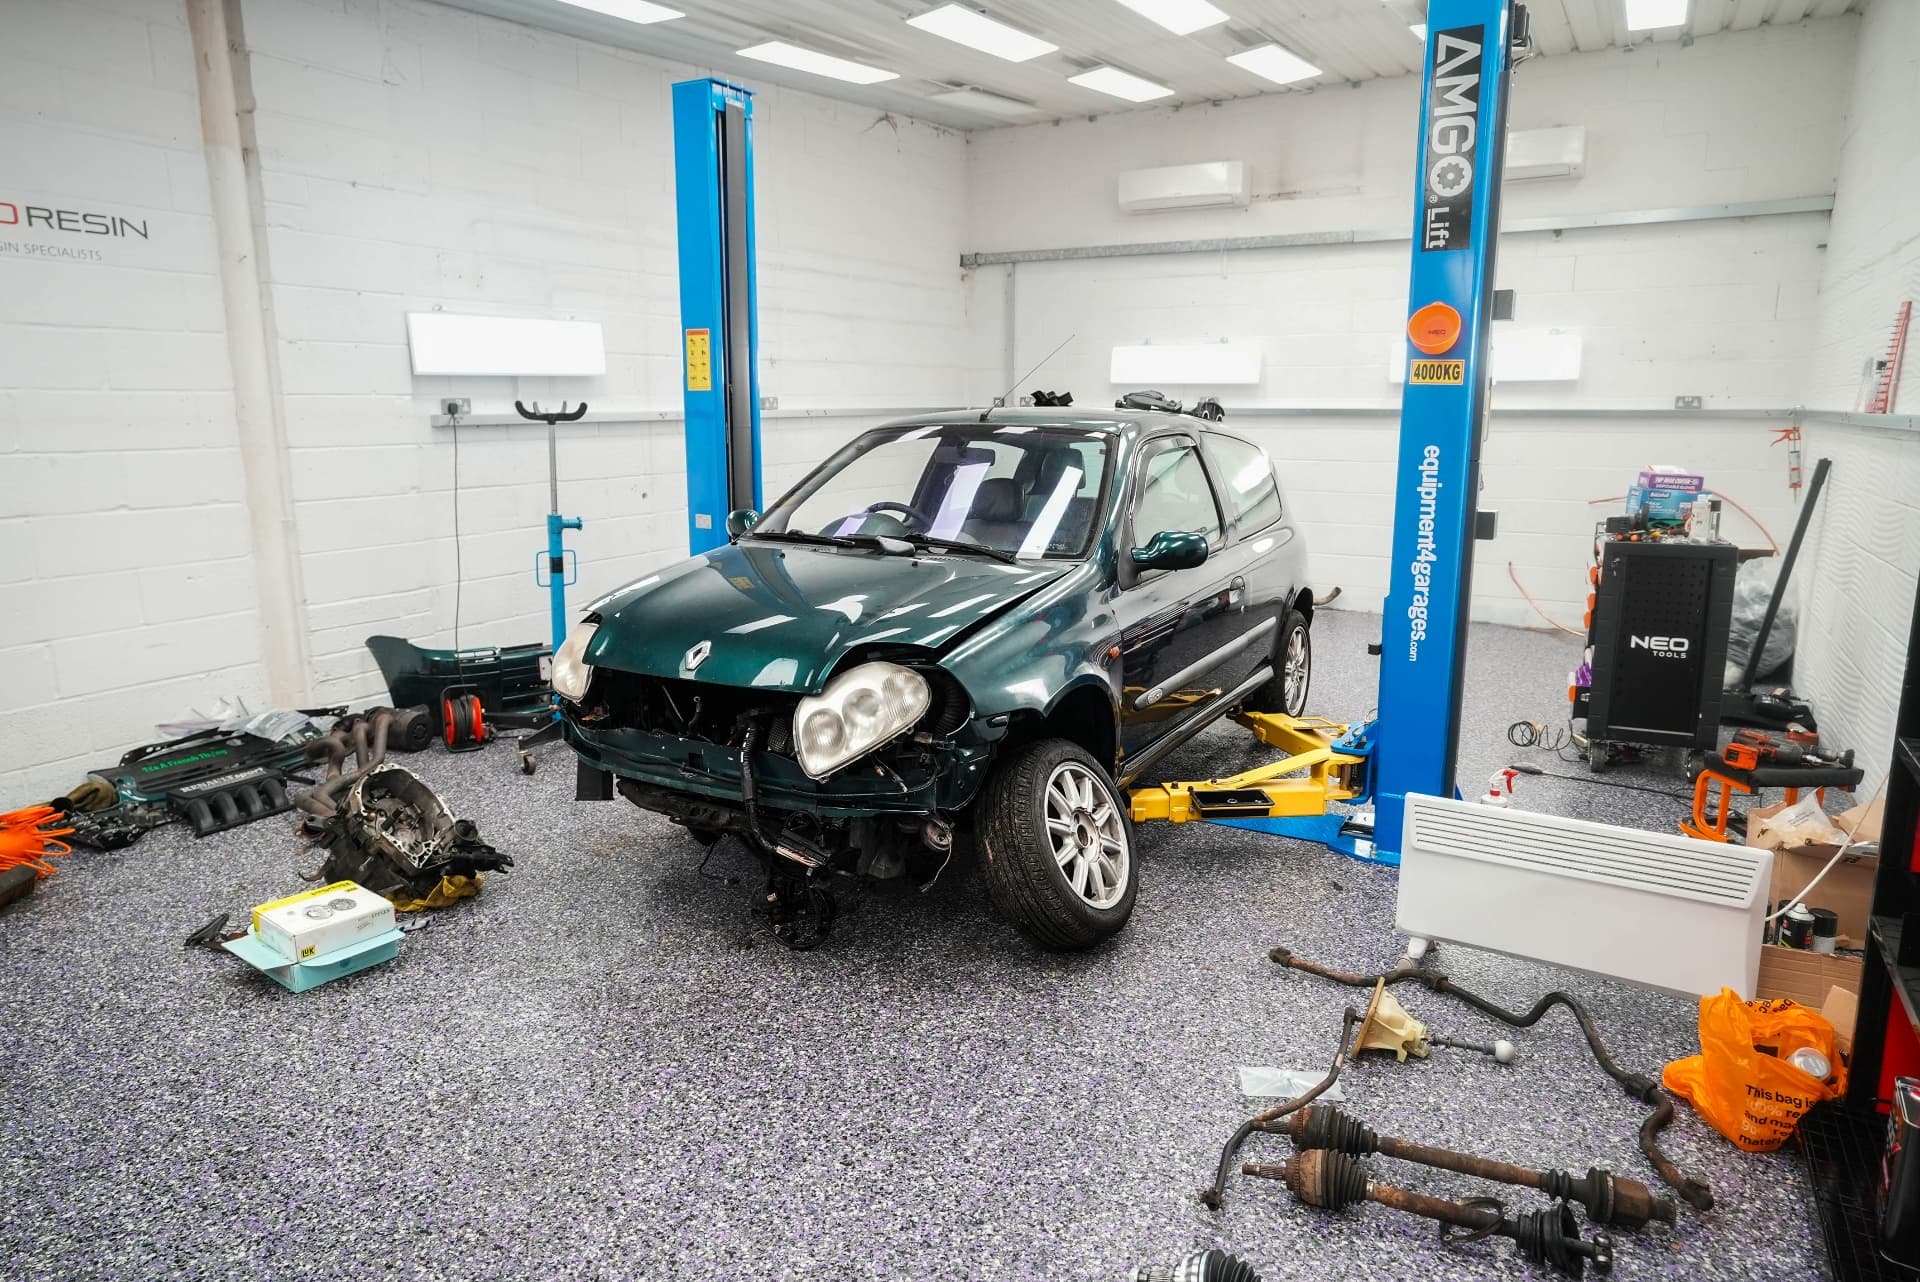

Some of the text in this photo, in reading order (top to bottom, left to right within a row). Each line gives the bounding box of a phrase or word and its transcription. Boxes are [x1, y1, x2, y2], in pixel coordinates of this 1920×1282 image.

[1427, 34, 1481, 249] AMGO Lift
[25, 206, 149, 240] RESIN
[24, 242, 102, 262] SPECIALISTS
[1413, 363, 1461, 381] 4000KG
[1630, 635, 1689, 651] NEO
[1652, 651, 1687, 659] TOOLS
[1745, 1084, 1773, 1101] This
[1775, 1090, 1803, 1109] bag
[1744, 1109, 1768, 1126] and
